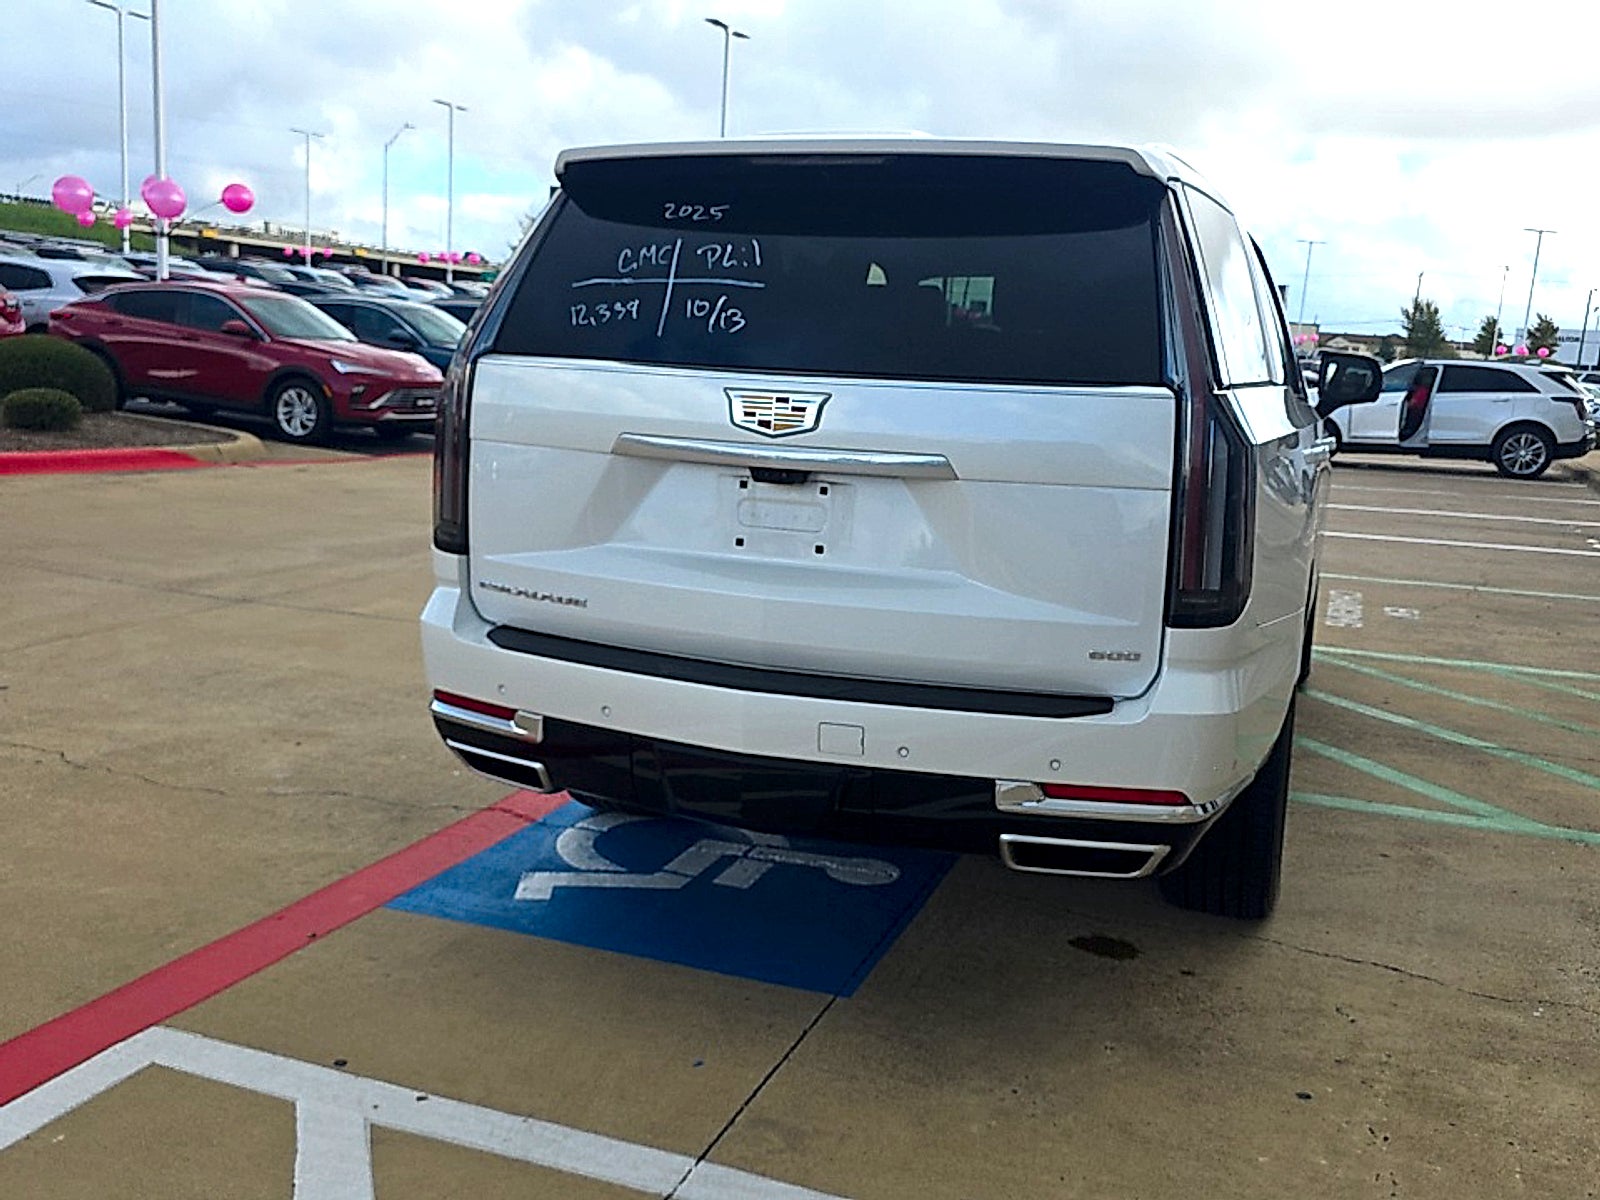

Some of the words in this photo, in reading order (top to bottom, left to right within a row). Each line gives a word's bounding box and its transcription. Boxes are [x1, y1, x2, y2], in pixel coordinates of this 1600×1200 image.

[664, 203, 730, 221] 2025
[618, 245, 672, 273] GMC
[686, 295, 747, 333] 10/13
